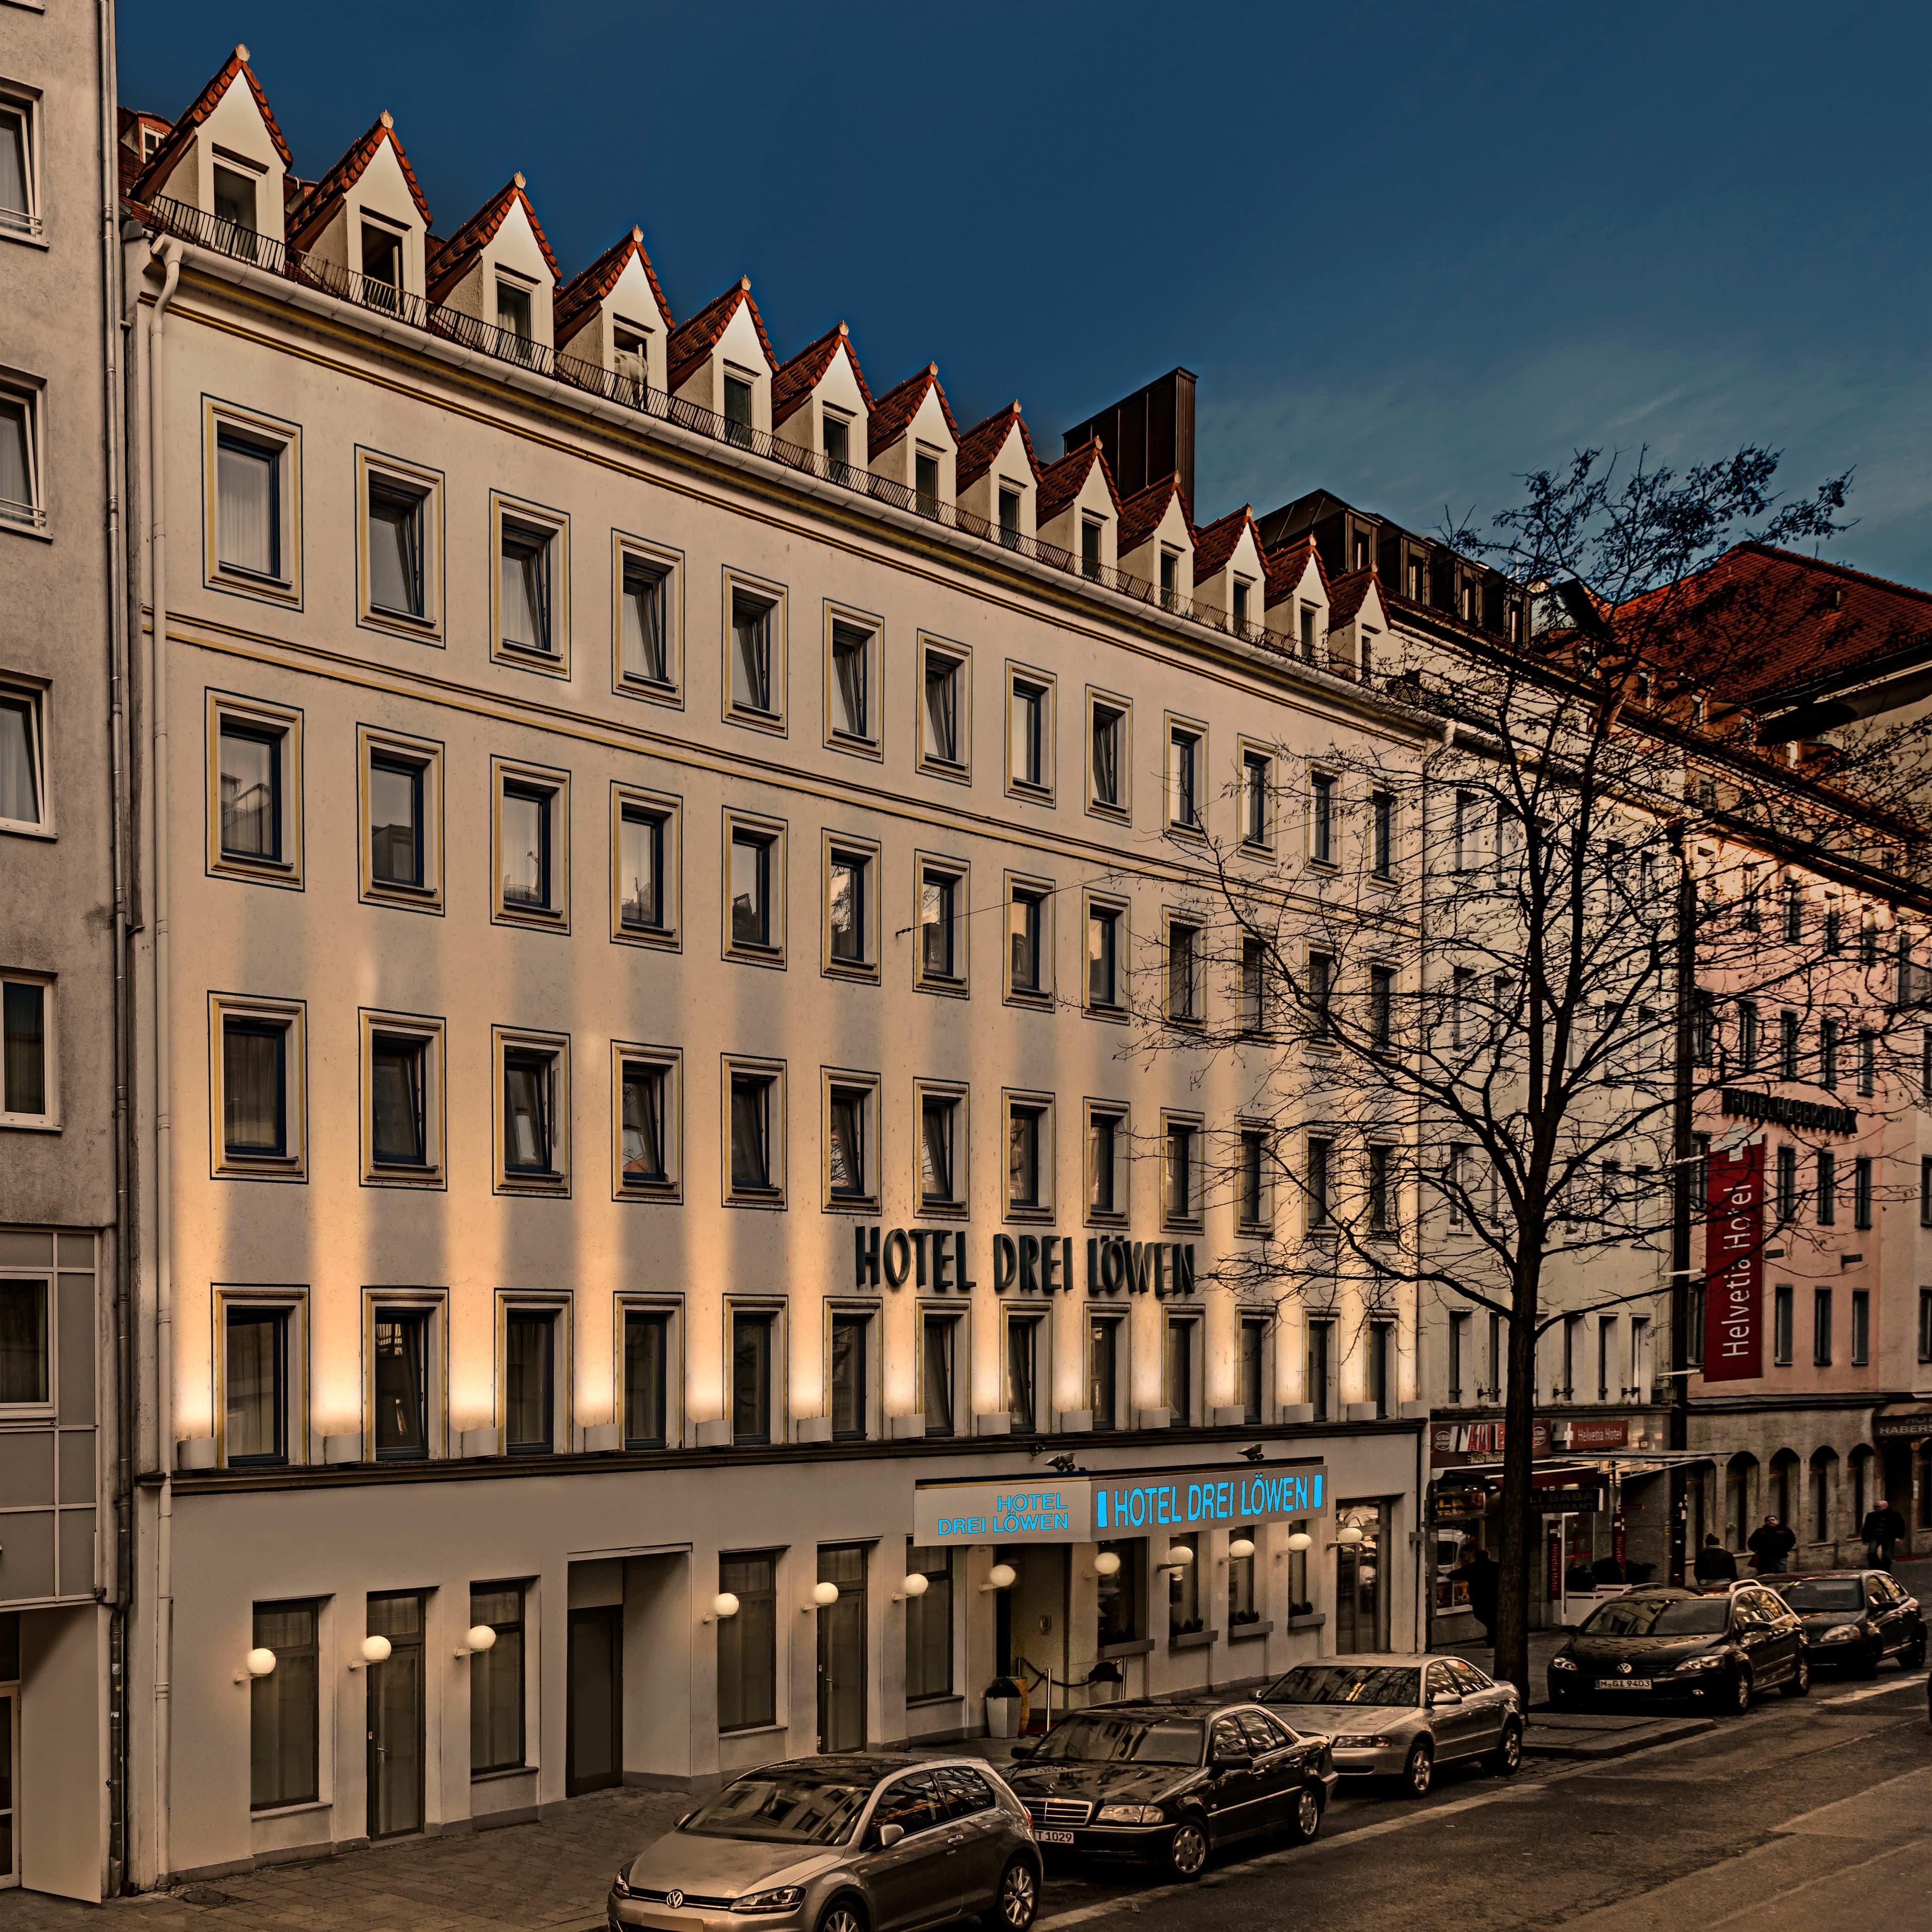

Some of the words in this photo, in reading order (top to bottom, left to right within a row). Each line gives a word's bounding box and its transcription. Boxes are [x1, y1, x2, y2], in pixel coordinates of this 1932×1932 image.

[855, 1226, 977, 1290] HOTEL
[993, 1233, 1074, 1293] DREI
[1087, 1235, 1195, 1296] LÖWEN
[1722, 1257, 1750, 1357] Helvetia
[1577, 1428, 1604, 1442] Helvetia
[1604, 1426, 1623, 1440] Hotel
[998, 1493, 1068, 1511] HOTEL
[1114, 1486, 1182, 1527] HOTEL
[1187, 1482, 1234, 1521] DREI
[1241, 1471, 1308, 1515] LÖWEN
[1530, 1494, 1542, 1503] LI
[1549, 1492, 1594, 1502] BABA
[1531, 1502, 1595, 1511] STAURANT
[938, 1517, 985, 1535] DREI
[993, 1510, 1068, 1533] LÖWEN
[1550, 1573, 1558, 1590] Hotel
[1034, 1830, 1043, 1840] T
[1045, 1832, 1072, 1841] 1029
